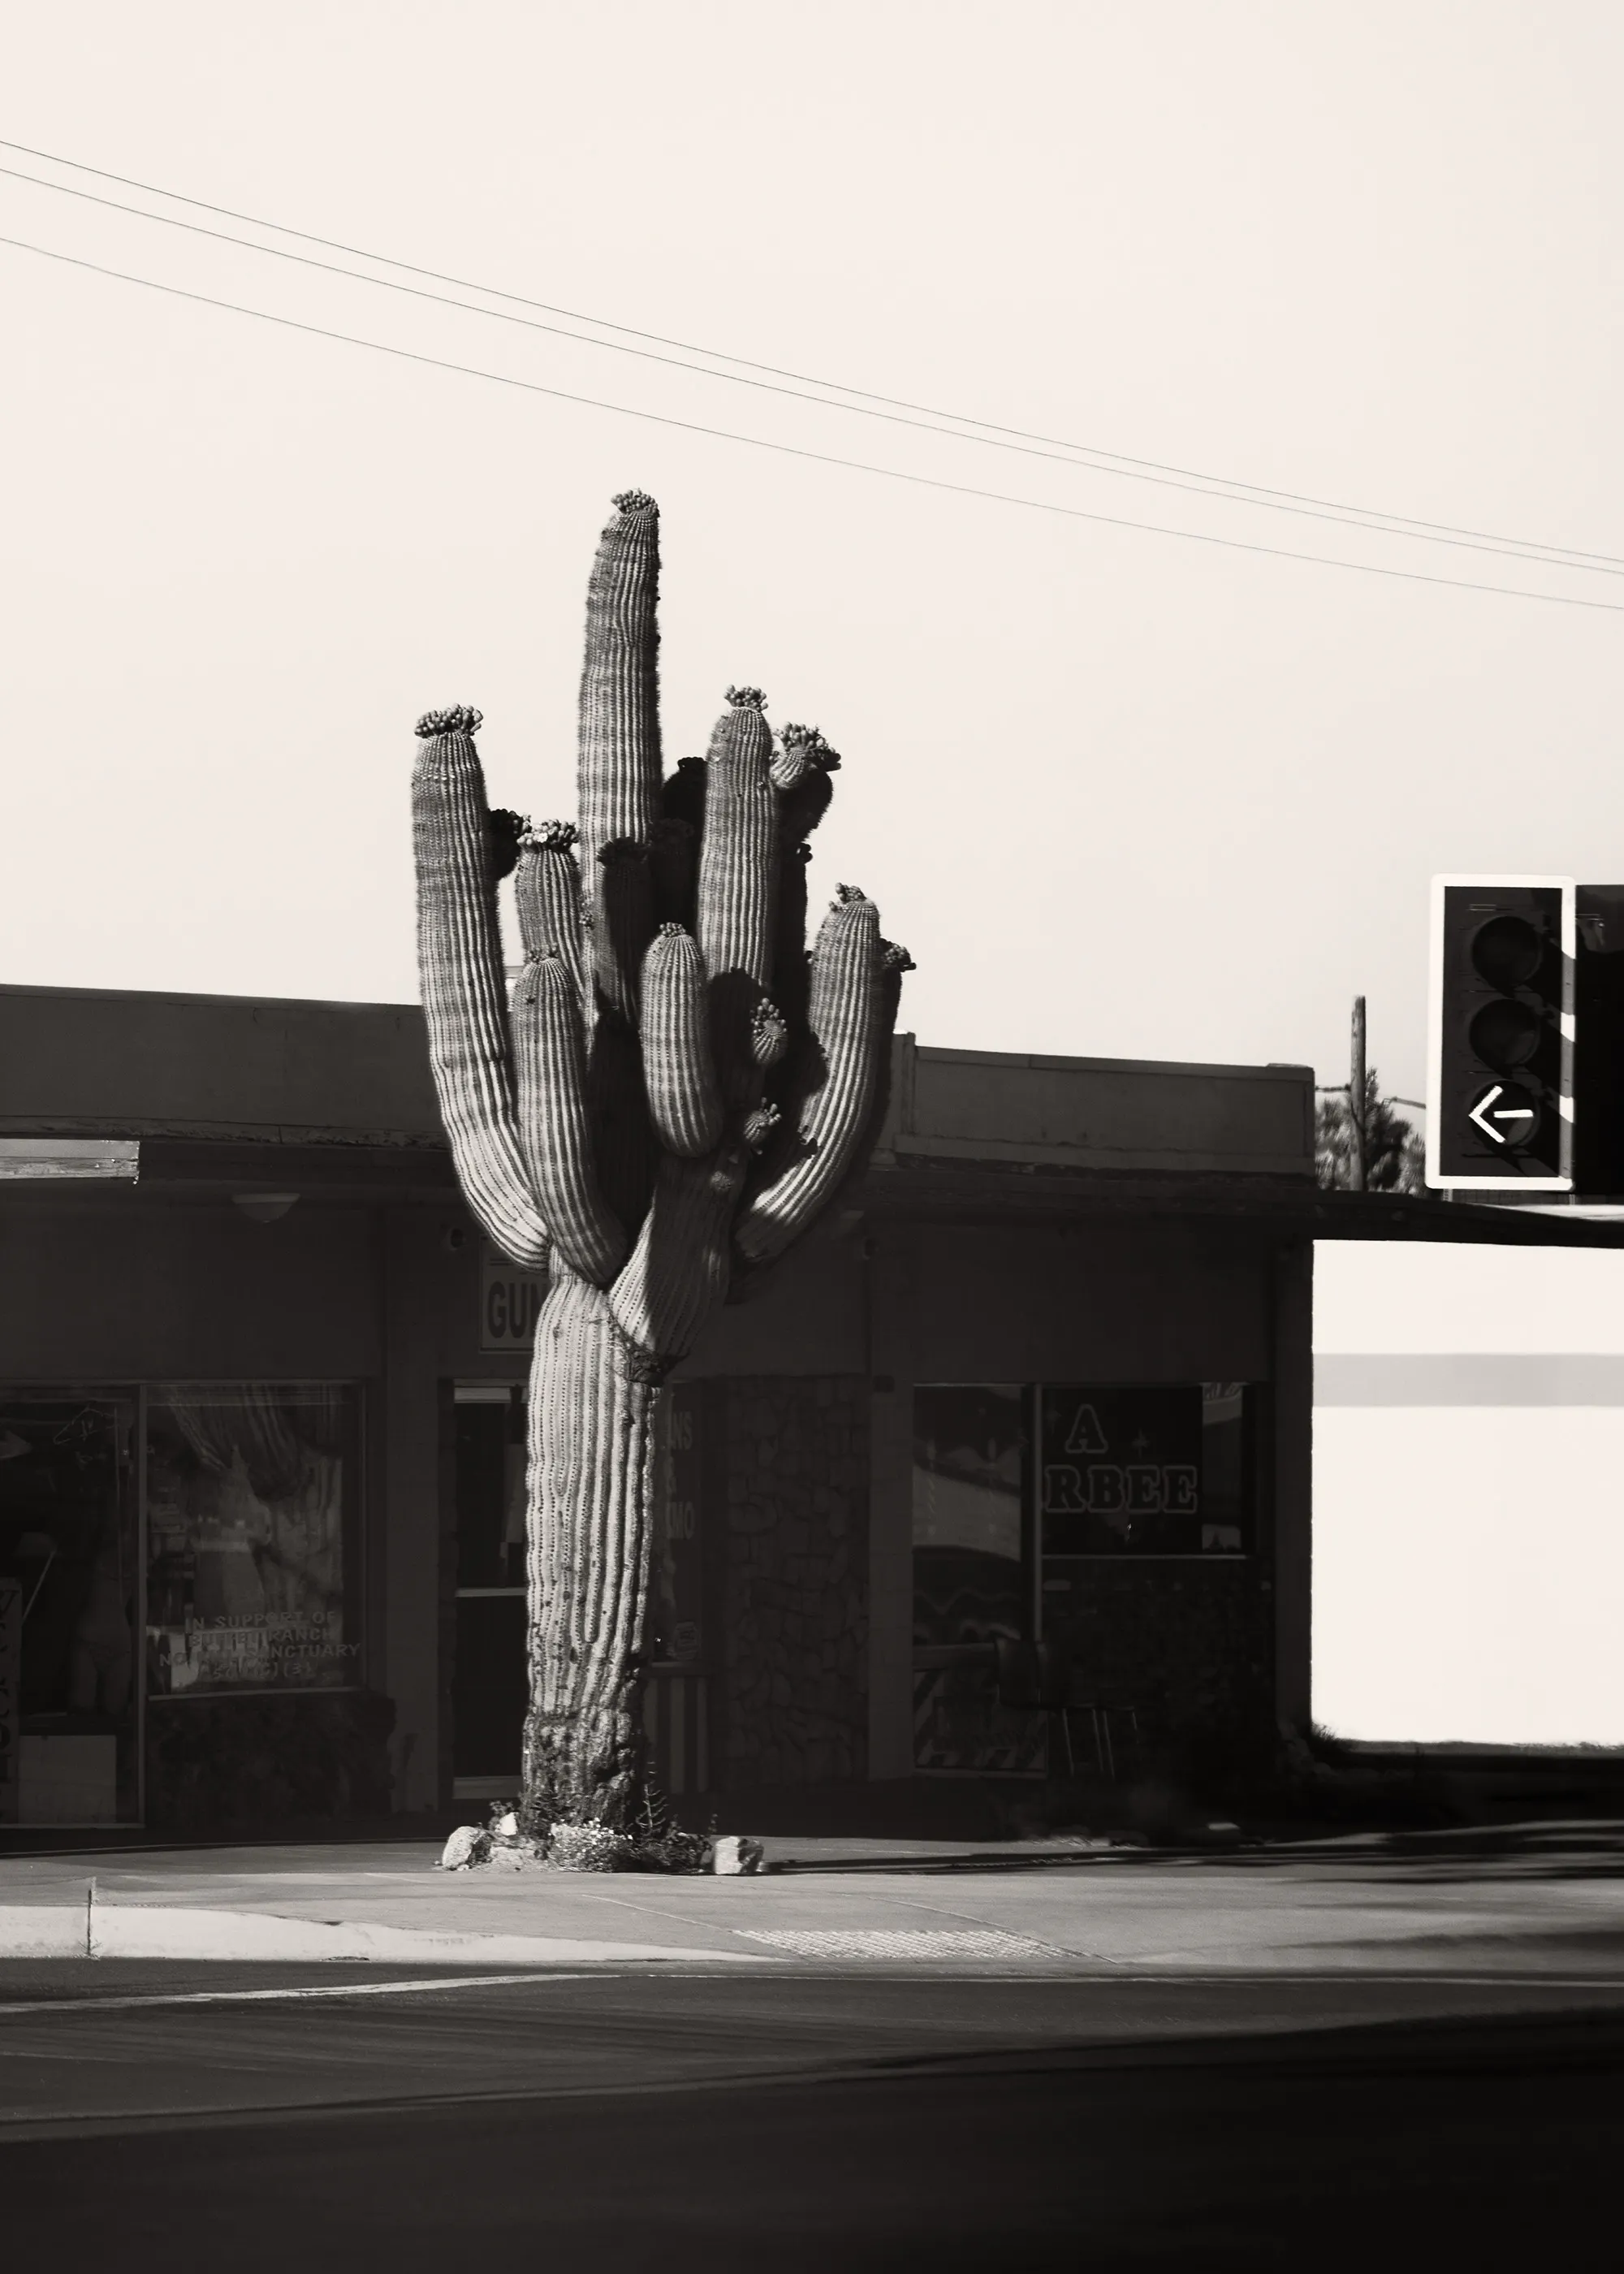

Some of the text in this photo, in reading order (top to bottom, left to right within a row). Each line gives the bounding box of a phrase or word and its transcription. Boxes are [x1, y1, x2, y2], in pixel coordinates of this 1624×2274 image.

[1065, 1403, 1108, 1454] A
[1044, 1463, 1198, 1514] RBEE
[186, 1611, 336, 1632] IN SUPPORT OF
[269, 1628, 333, 1642] RANCH
